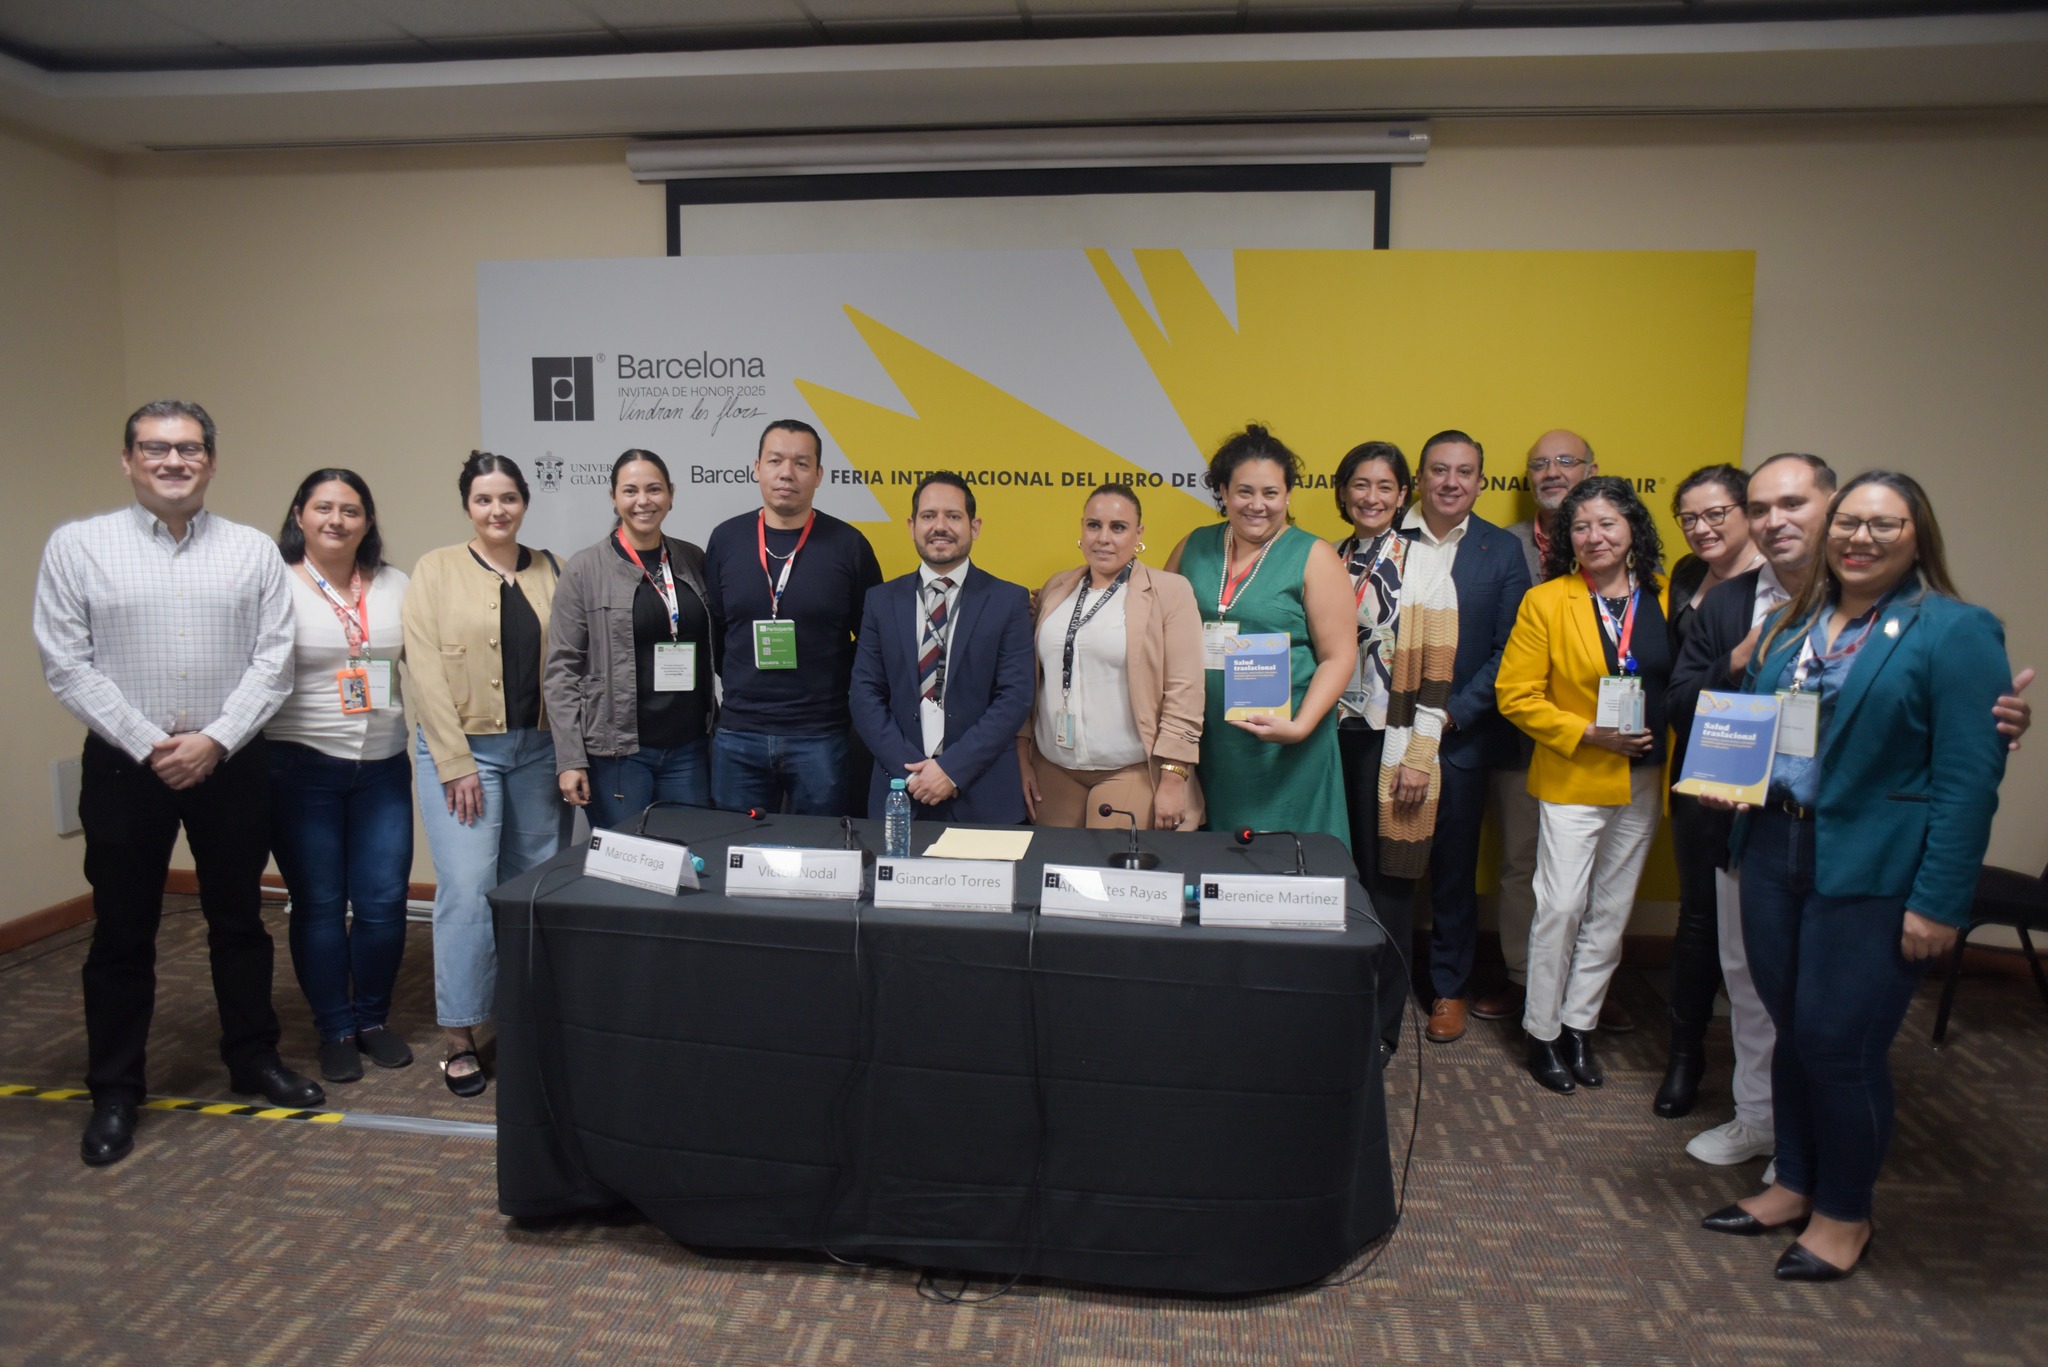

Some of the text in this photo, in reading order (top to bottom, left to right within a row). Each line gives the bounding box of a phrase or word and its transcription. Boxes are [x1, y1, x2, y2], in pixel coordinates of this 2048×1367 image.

[618, 351, 765, 379] Barcelona
[618, 385, 766, 398] INVITADA DE HONOR 2025
[618, 396, 684, 422] Vindran
[689, 403, 709, 421] les
[570, 463, 613, 473] UNIVER
[691, 465, 759, 484] Barcelo
[831, 470, 884, 486] FERIA
[891, 470, 1054, 487] INTACIONAL
[1061, 472, 1097, 487] DEL
[1105, 472, 1164, 488] LIBRO
[1171, 473, 1197, 488] DE
[1703, 722, 1730, 731] Salud
[1702, 729, 1757, 741] traslacional
[605, 846, 665, 871] Marcos Fraga
[799, 867, 837, 880] Nodal
[896, 872, 1001, 888] Giancarlo Torres
[1130, 885, 1168, 902] Rayas
[1217, 889, 1274, 903] Berenice
